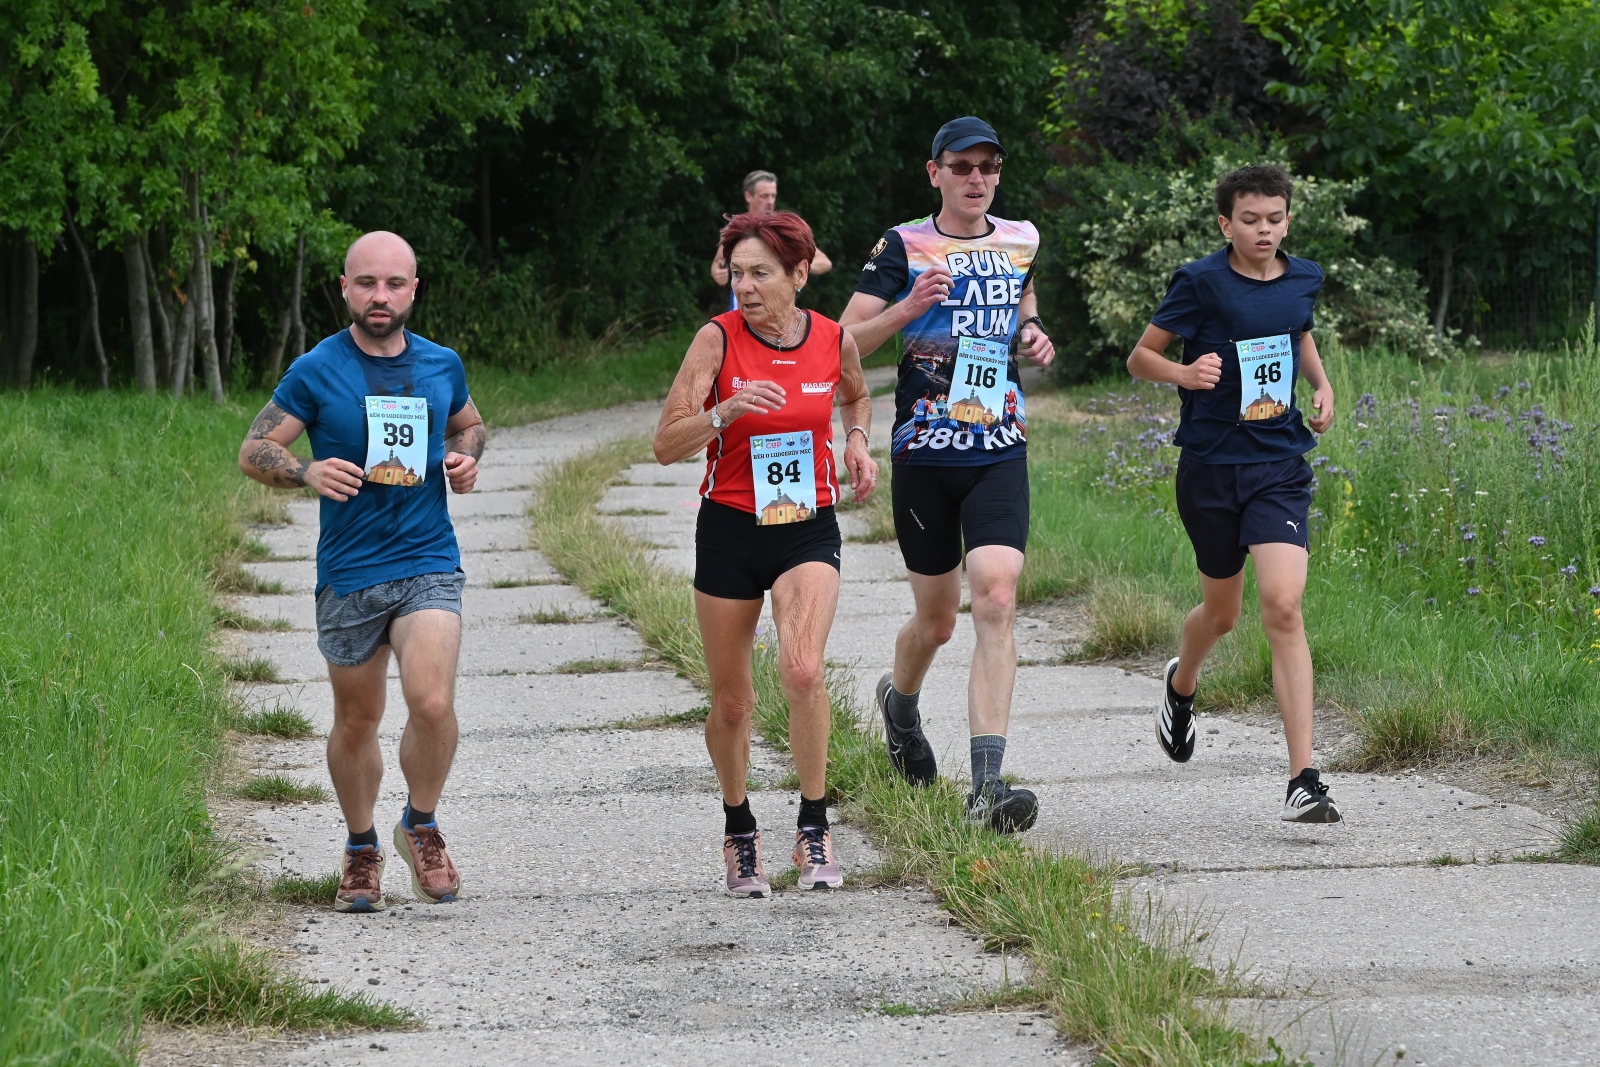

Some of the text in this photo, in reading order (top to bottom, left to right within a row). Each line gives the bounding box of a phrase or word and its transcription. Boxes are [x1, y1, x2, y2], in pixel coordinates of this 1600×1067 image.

[946, 251, 1014, 277] RUN
[941, 279, 1021, 306] LABE
[951, 308, 1014, 337] RUN
[964, 363, 998, 389] 116
[1254, 360, 1282, 386] 46
[383, 422, 414, 448] 39
[766, 441, 782, 449] CUP
[907, 423, 1026, 450] 380 KM
[767, 459, 801, 485] 84
